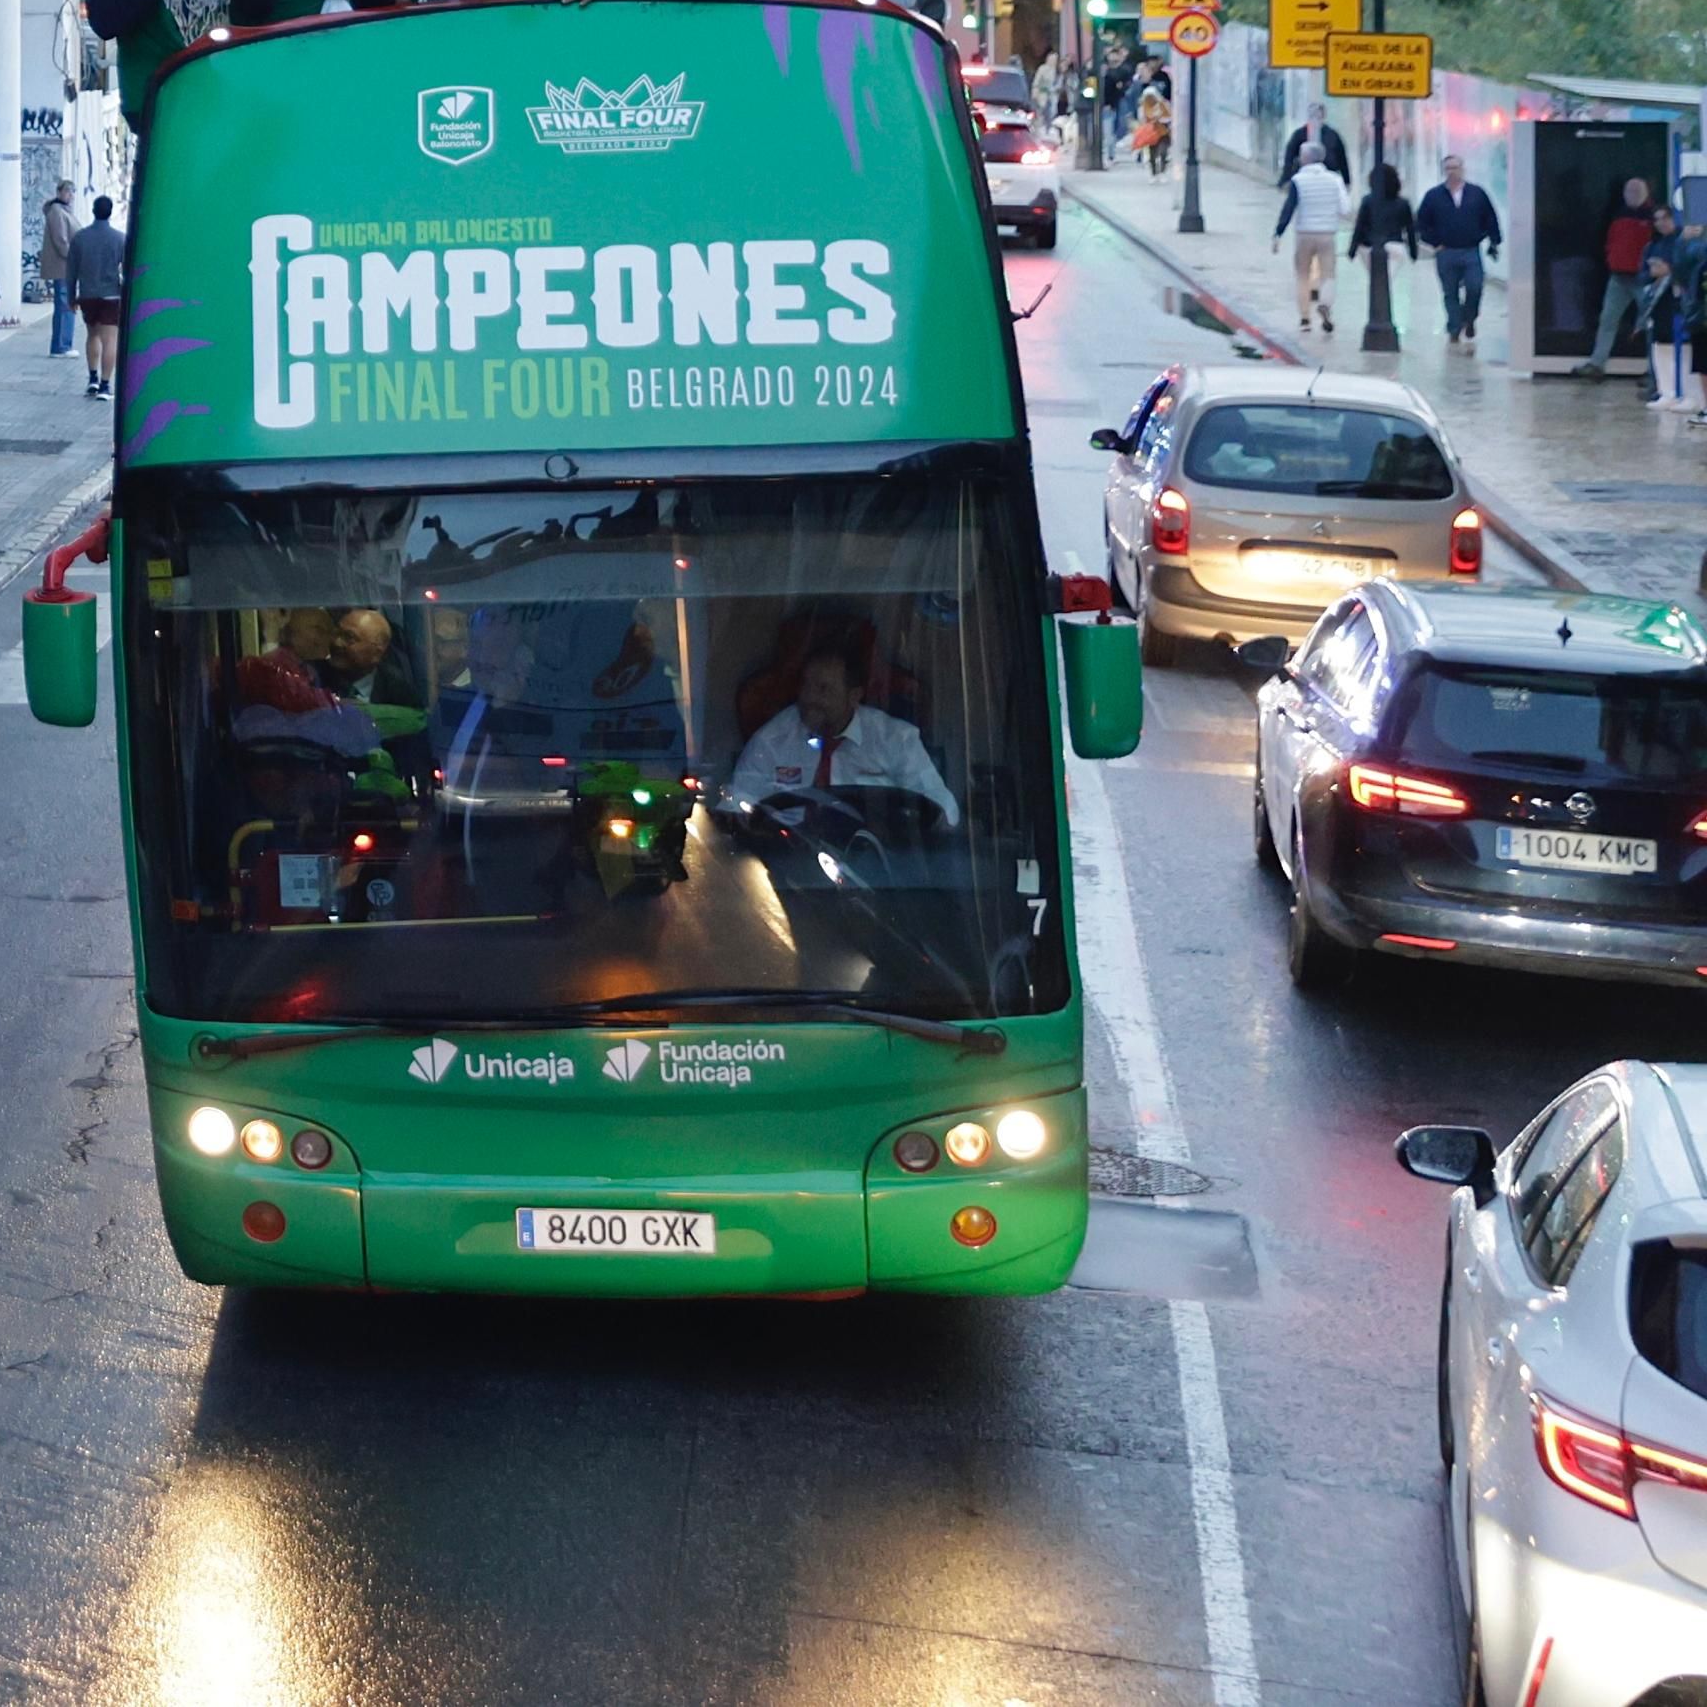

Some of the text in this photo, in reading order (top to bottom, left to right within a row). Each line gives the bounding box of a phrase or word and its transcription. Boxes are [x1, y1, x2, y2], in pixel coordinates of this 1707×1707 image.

[430, 120, 482, 132] Fundación
[537, 108, 693, 131] FINAL FOUR
[437, 131, 476, 142] Unicaja
[319, 216, 554, 247] UNICAJA BALONCESTO
[247, 213, 897, 429] CAMPEONES
[328, 356, 899, 423] FINAL FOUR BELGRADO 2024
[1522, 832, 1587, 861] 1004
[1598, 839, 1649, 867] KMC
[658, 1039, 786, 1063] Fundación
[464, 1050, 575, 1084] Unicaja
[659, 1062, 752, 1088] Unicaja
[547, 1214, 628, 1245] 8400
[641, 1215, 701, 1247] GXK
